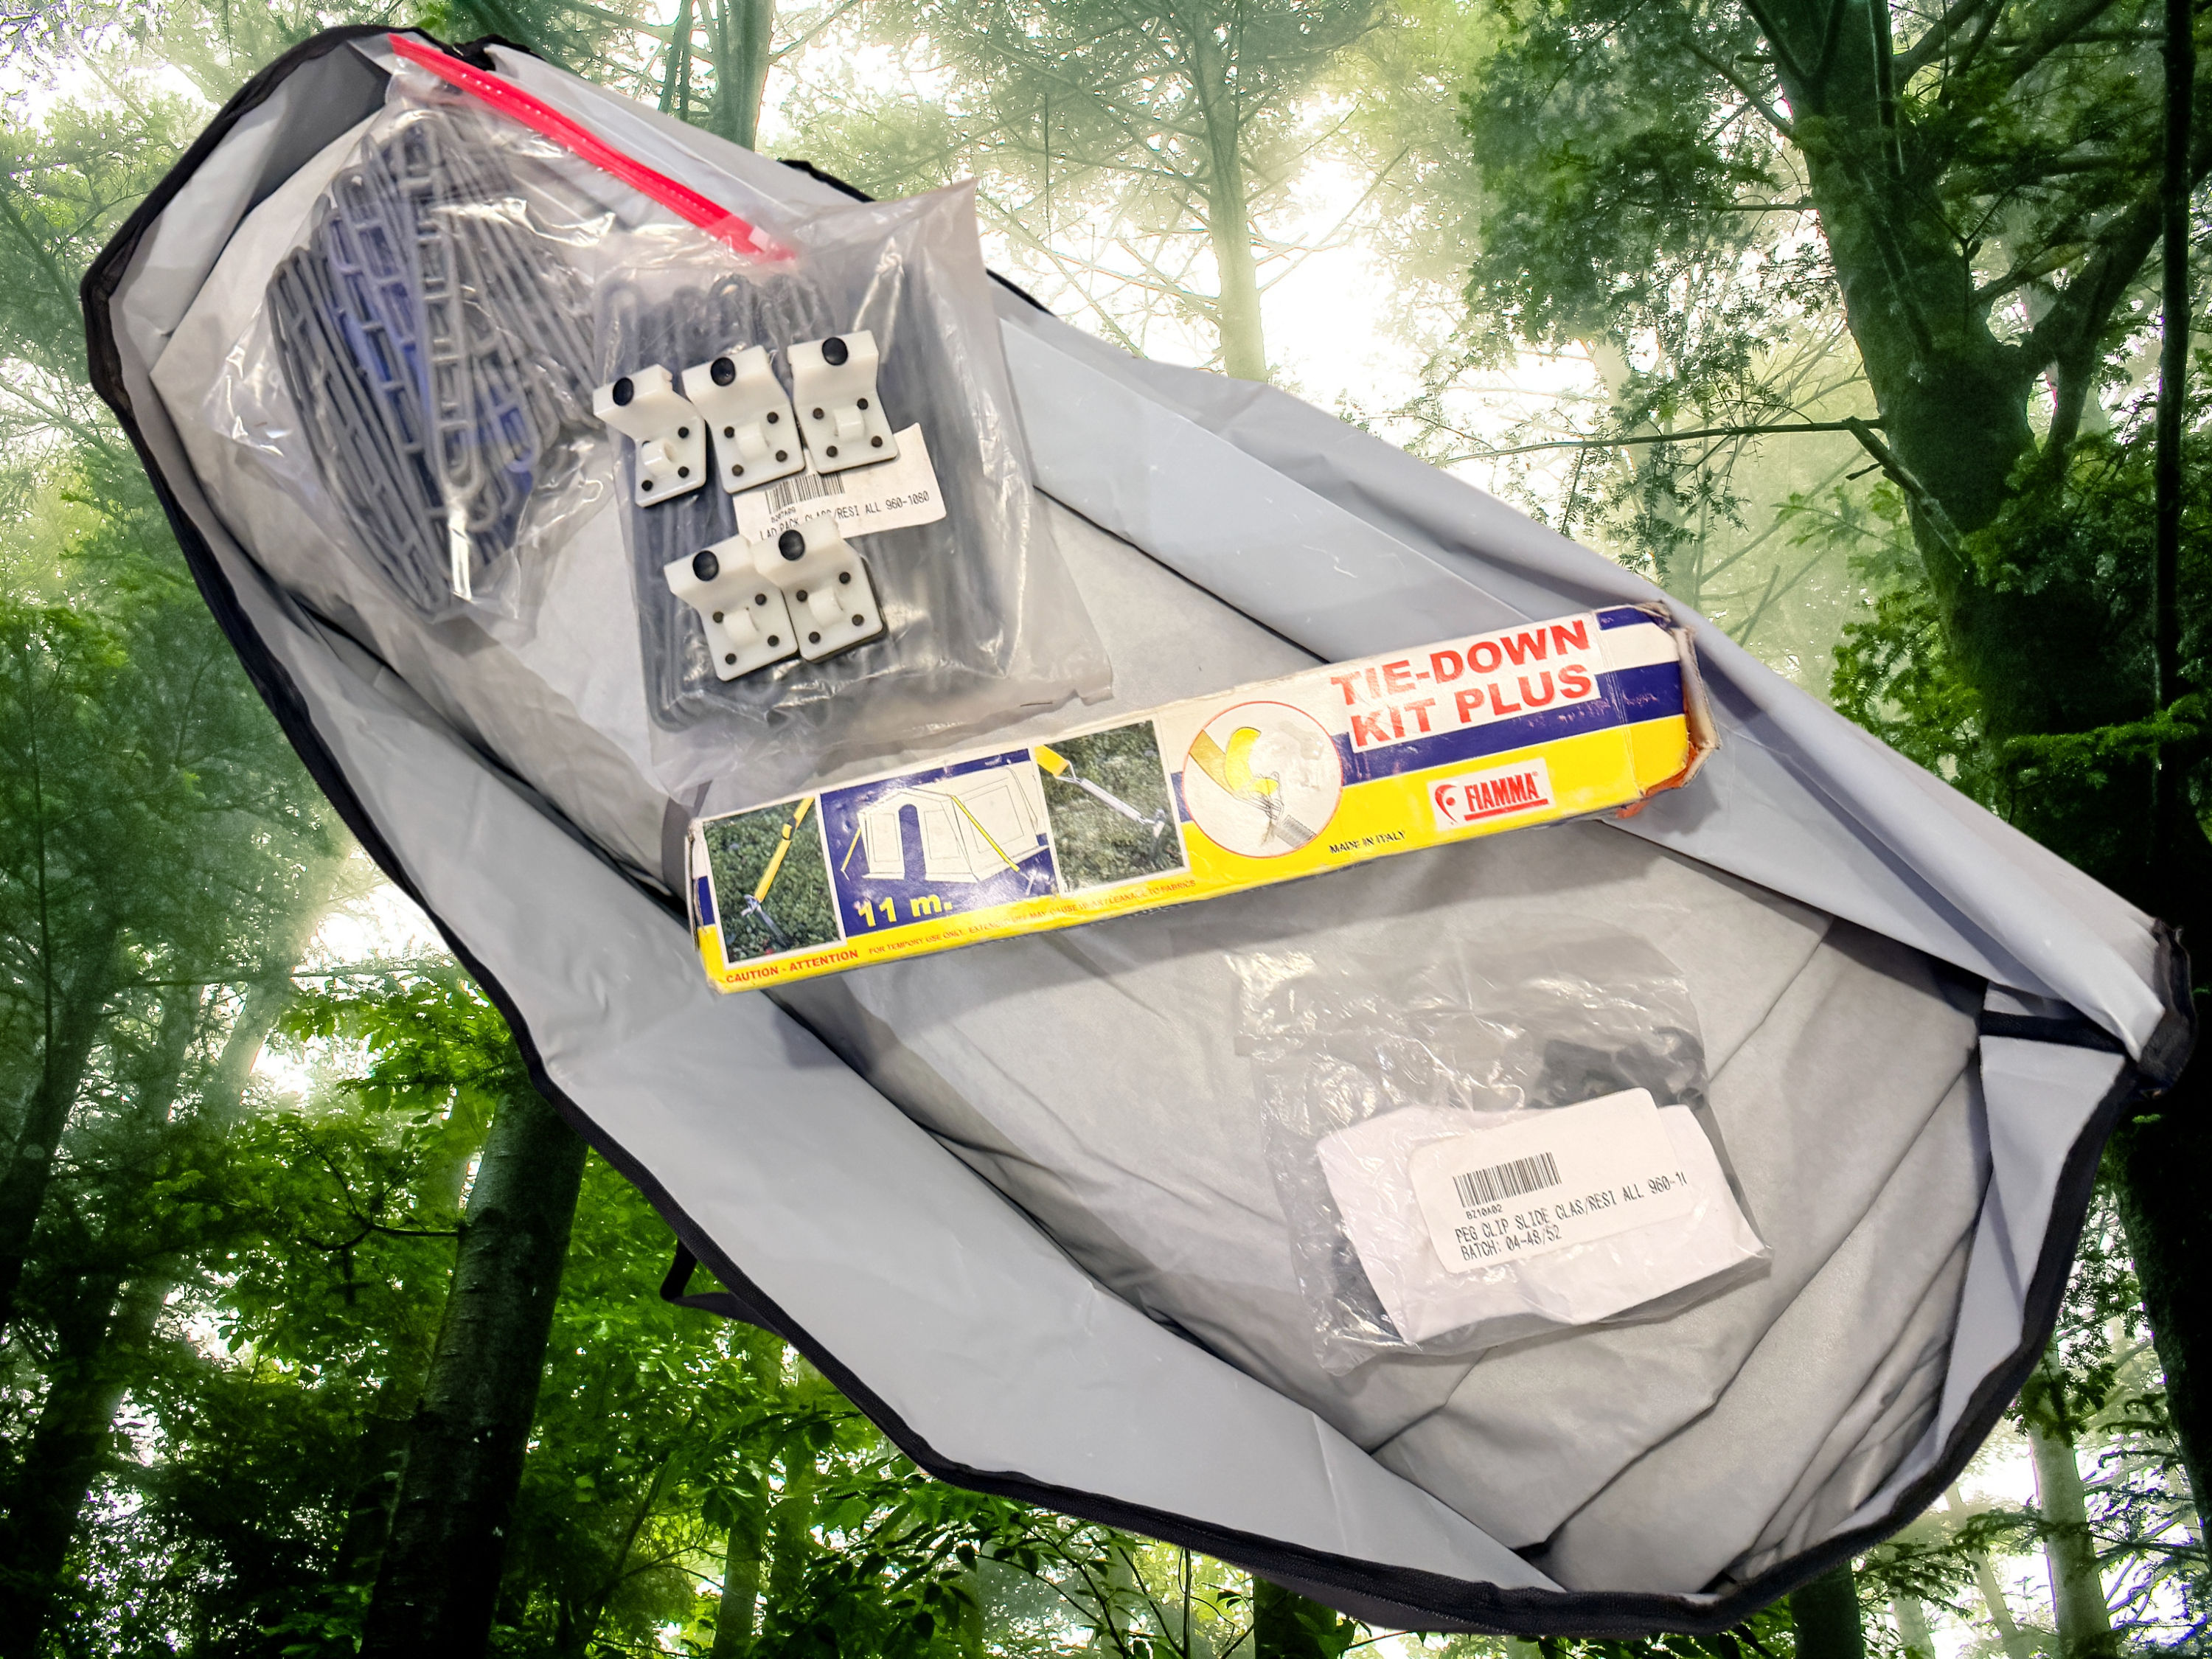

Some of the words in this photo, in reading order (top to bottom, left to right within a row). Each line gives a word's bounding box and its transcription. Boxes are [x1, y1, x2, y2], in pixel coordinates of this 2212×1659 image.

[865, 501, 882, 515] ALL
[886, 490, 930, 510] 960-1080
[1330, 619, 1590, 706] TIE-DOWN
[1350, 698, 1436, 747] KIT
[1454, 664, 1593, 723] PLUS
[1464, 772, 1540, 812] FIAMMA
[1329, 840, 1360, 854] MADE
[1362, 837, 1374, 846] IN
[1376, 830, 1405, 844] ITALY
[854, 897, 897, 928] 11
[910, 894, 953, 918] m.
[726, 966, 779, 984] CAUTION
[790, 949, 859, 972] ATTENTION
[869, 946, 886, 954] FOR
[925, 934, 942, 943] USE
[1029, 911, 1048, 919] MAY
[1455, 1225, 1478, 1244] PEG
[1481, 1217, 1509, 1238] CLIP
[1514, 1207, 1551, 1231] SLIDE
[1621, 1183, 1645, 1203] ALL
[1466, 1203, 1503, 1220] BZ10A02
[1461, 1238, 1502, 1262] BATCH:
[1506, 1224, 1562, 1251] 04-48/52
